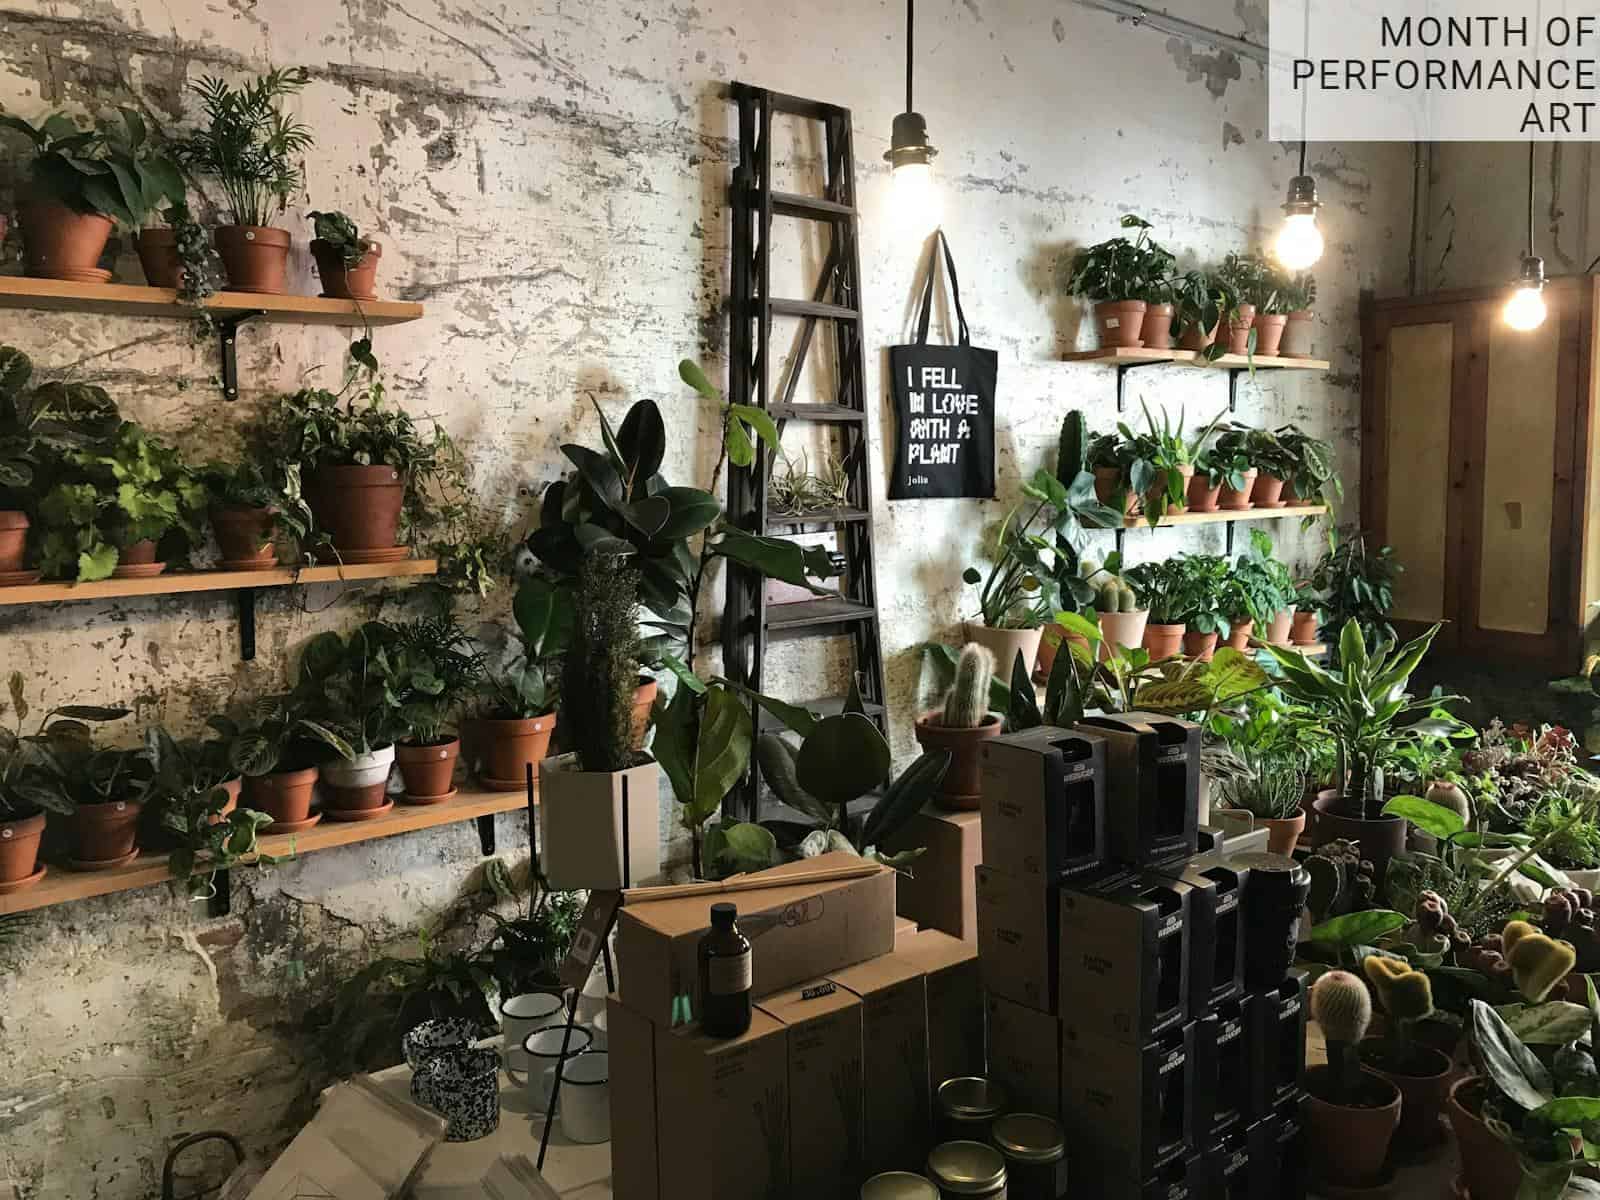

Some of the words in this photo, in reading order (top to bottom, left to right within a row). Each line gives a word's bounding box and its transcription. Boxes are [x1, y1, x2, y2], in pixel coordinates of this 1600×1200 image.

[907, 366, 913, 388] I
[921, 367, 962, 389] FELL
[909, 391, 925, 414] IN
[932, 392, 979, 415] LOVE
[909, 418, 950, 440] WITH
[957, 418, 971, 440] A
[908, 443, 961, 465] PLANT
